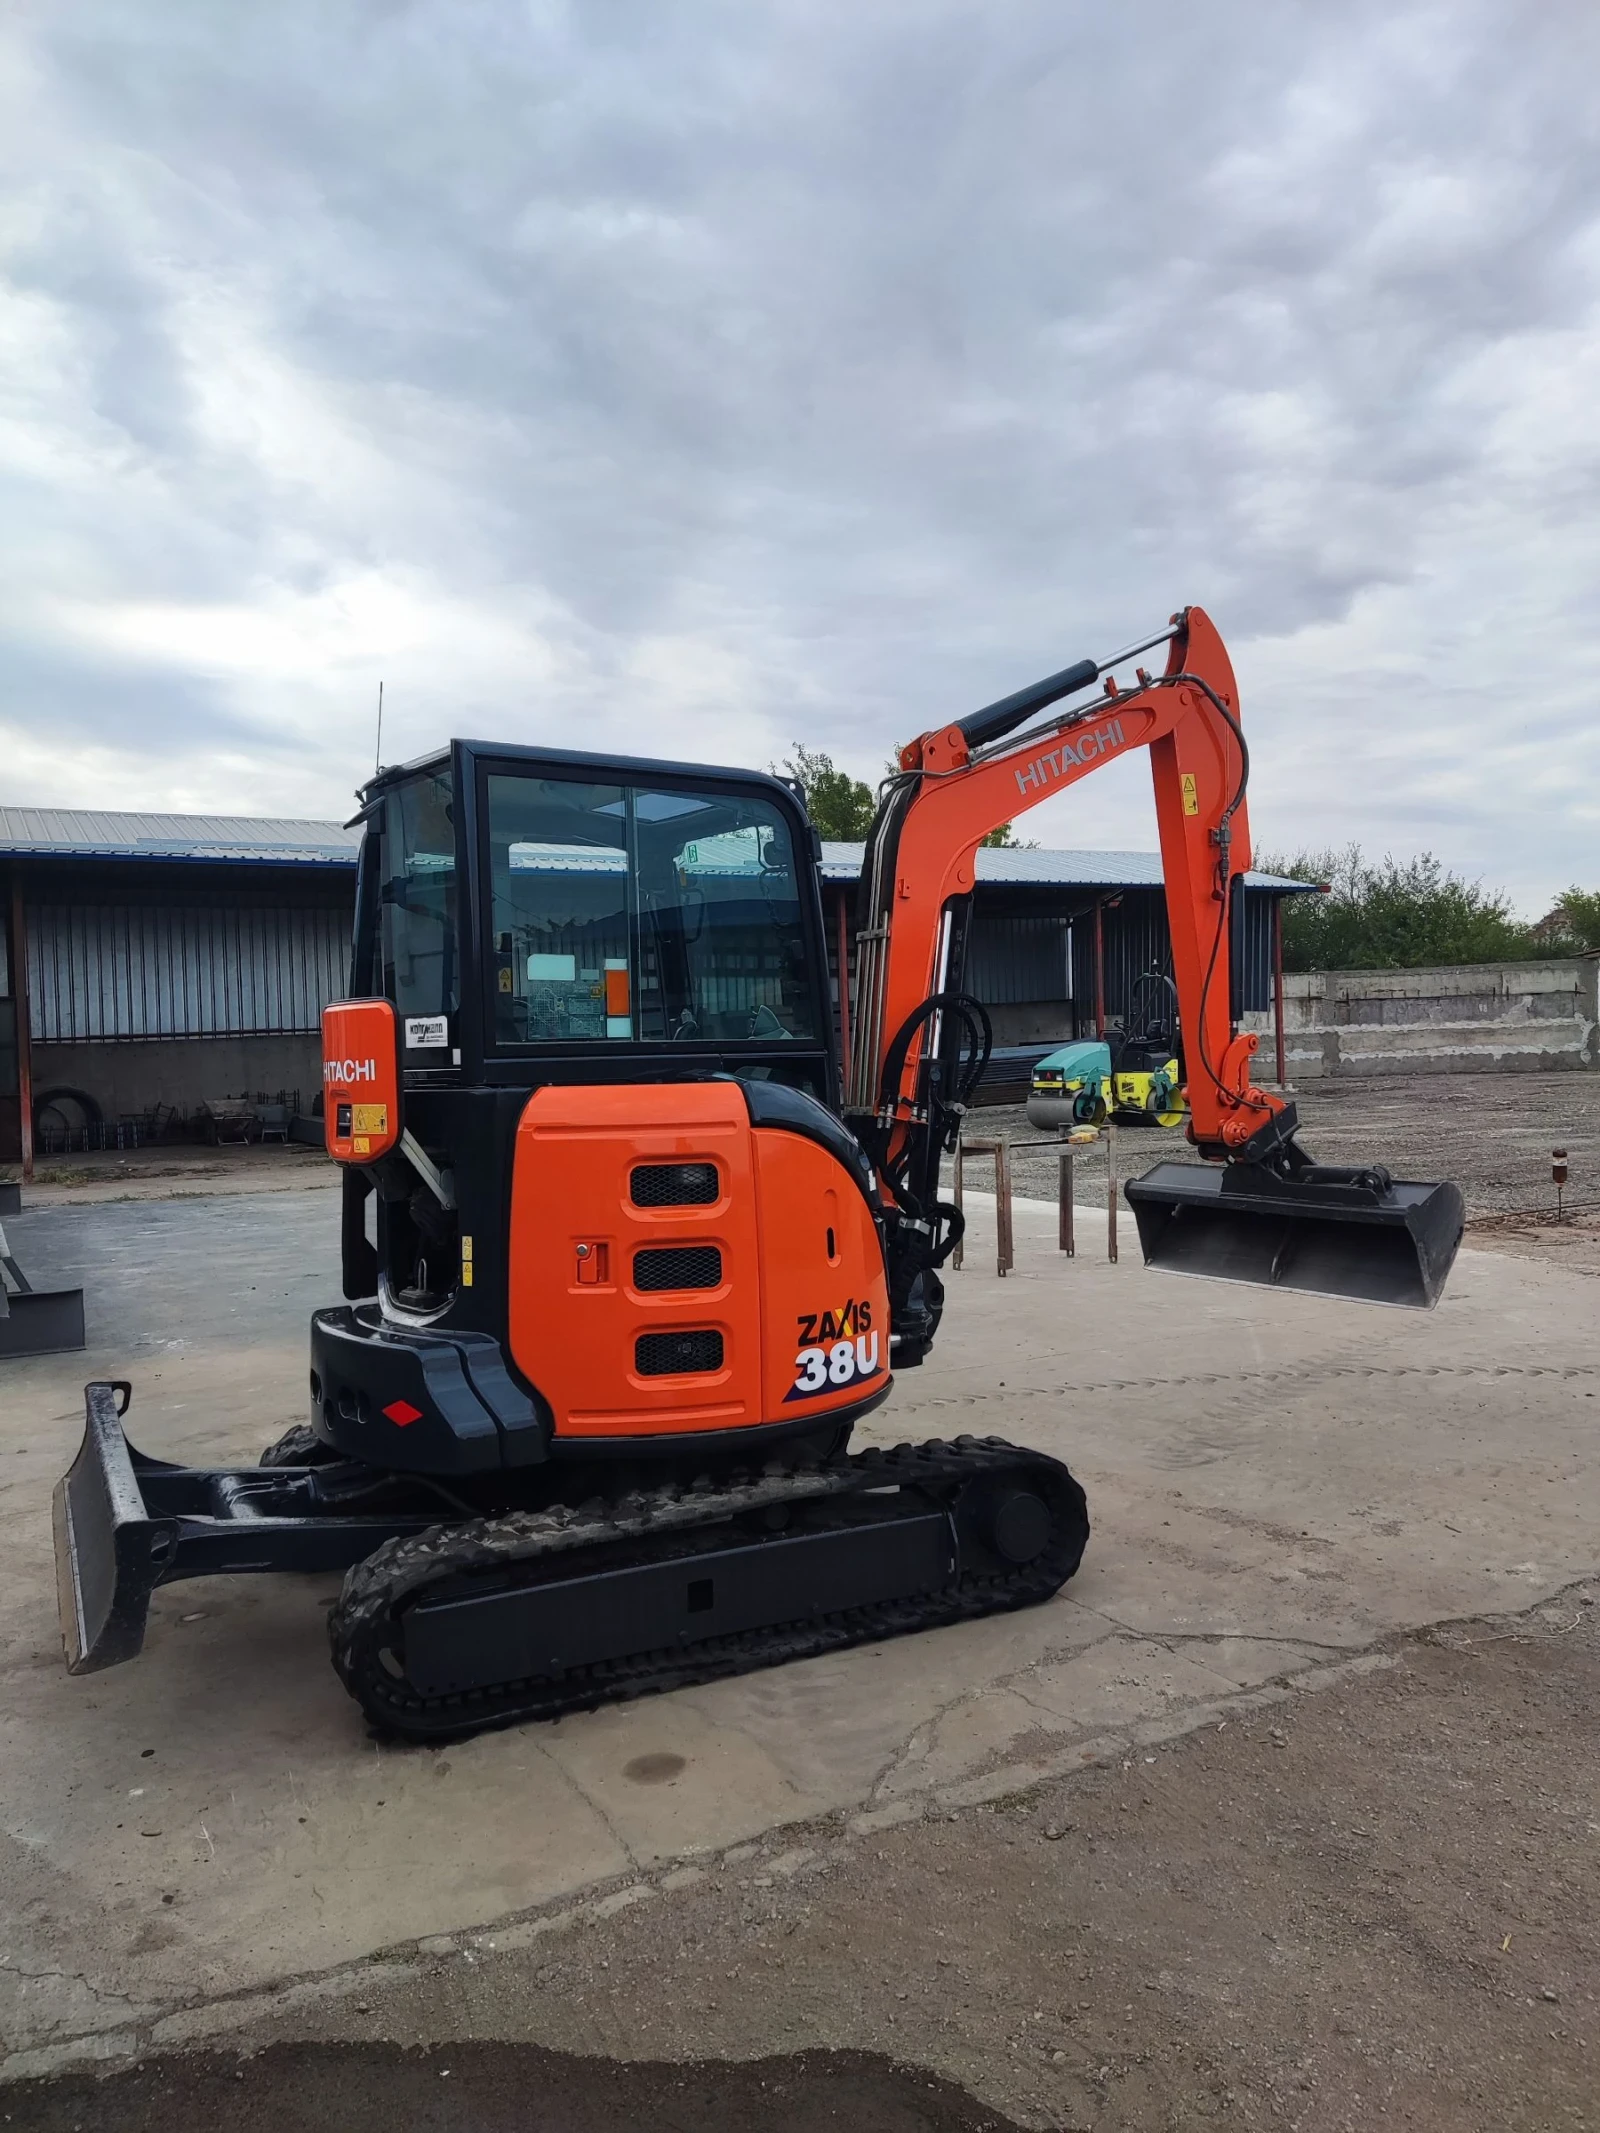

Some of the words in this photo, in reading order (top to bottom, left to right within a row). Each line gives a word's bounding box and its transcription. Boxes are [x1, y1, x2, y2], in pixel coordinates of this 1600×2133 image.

[1014, 719, 1126, 795] HITACHI
[323, 1059, 375, 1082] HITACHI
[798, 1298, 872, 1347] ZAXIS
[795, 1330, 878, 1392] 38U
